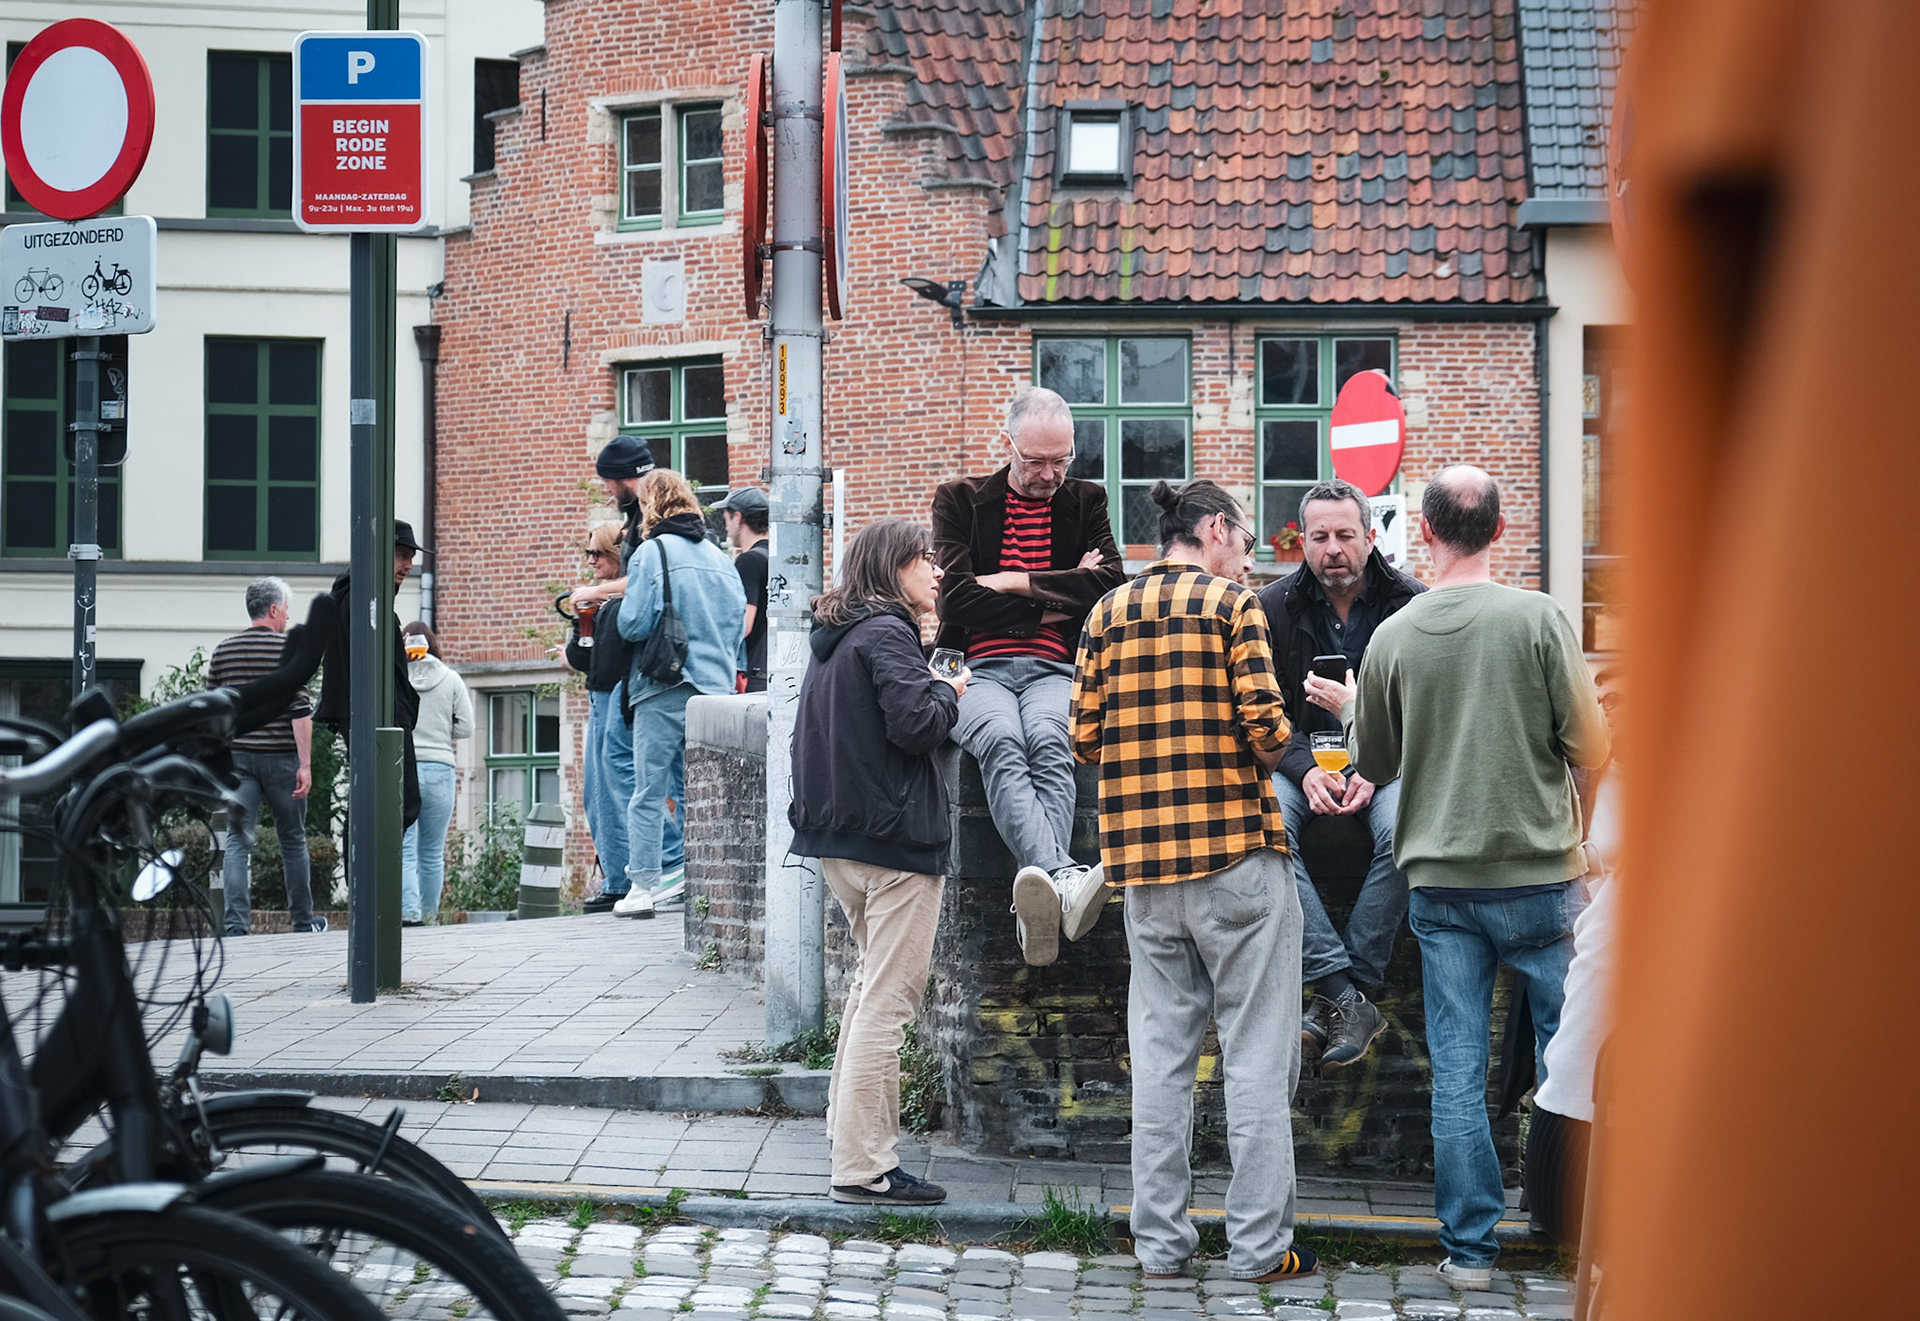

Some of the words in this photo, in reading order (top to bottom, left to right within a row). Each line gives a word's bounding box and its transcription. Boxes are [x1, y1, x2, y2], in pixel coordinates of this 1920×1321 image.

[348, 51, 376, 84] P
[333, 120, 389, 134] BEGIN
[336, 138, 386, 152] RODE
[336, 156, 386, 170] ZONE
[315, 193, 407, 201] MAANDAG-ZATERDAG
[379, 204, 395, 213] (tot
[397, 204, 414, 213] 19u)
[24, 228, 124, 249] UITGEZONDERD
